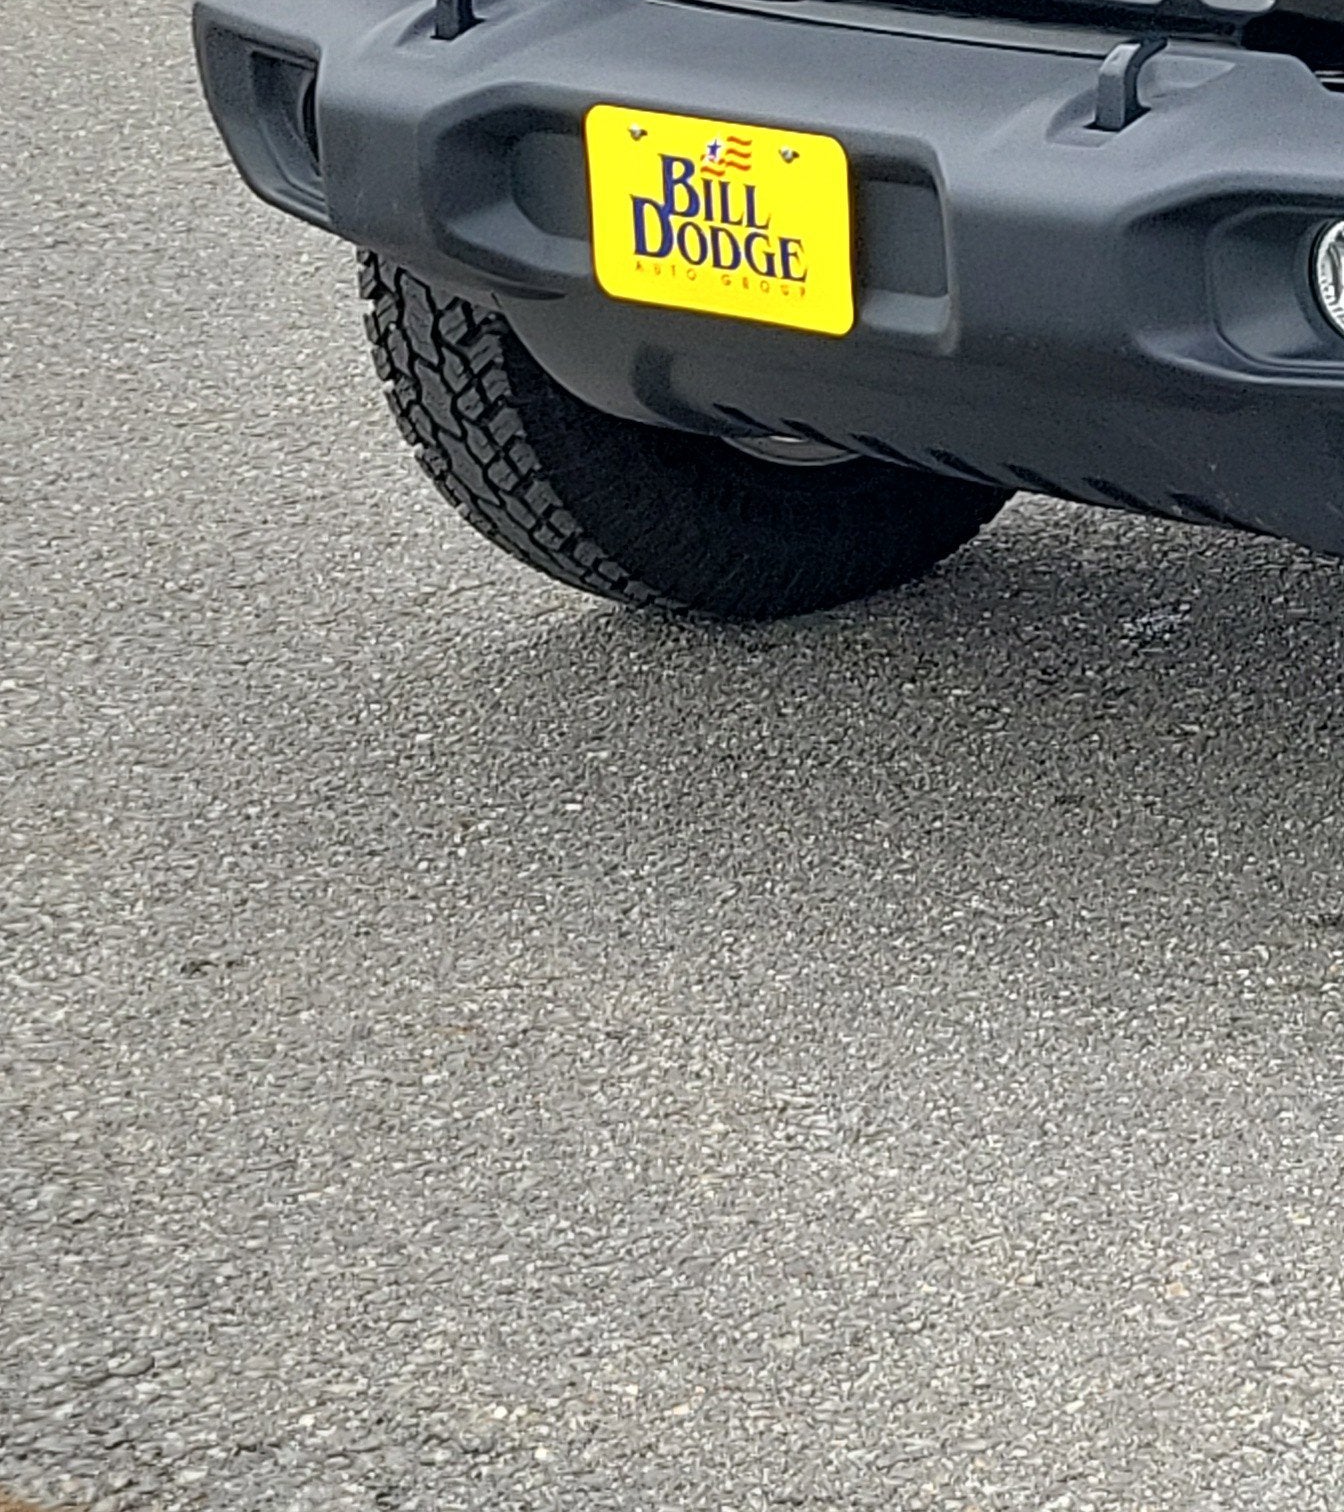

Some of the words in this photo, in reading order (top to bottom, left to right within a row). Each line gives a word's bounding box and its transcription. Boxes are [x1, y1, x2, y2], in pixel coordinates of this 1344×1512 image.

[657, 153, 771, 230] BILL
[629, 194, 808, 283] DODGE
[635, 260, 697, 281] AUTO
